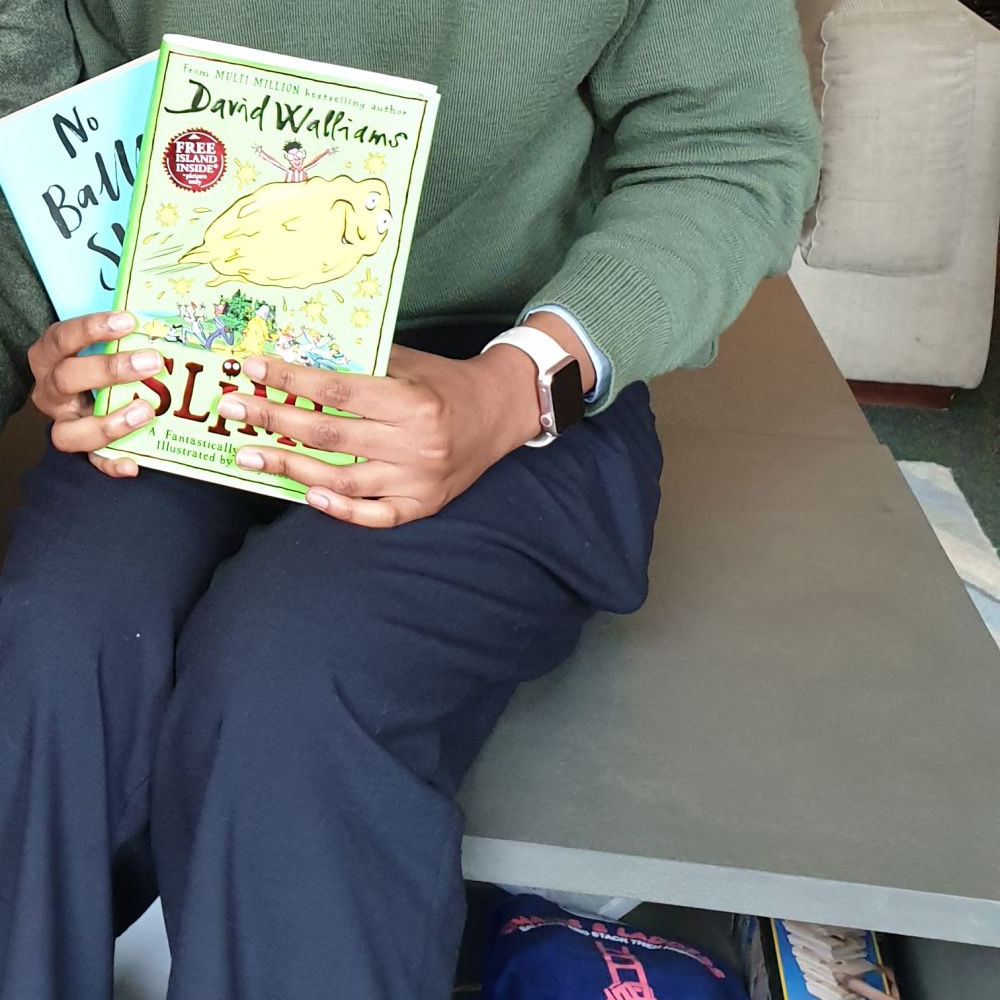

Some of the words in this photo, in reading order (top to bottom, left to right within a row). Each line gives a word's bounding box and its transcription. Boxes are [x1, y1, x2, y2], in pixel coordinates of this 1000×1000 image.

[253, 76, 301, 96] MILLION
[304, 88, 366, 111] bestselling
[370, 101, 407, 116] author
[164, 78, 271, 132] David
[275, 100, 408, 148] Walliams
[52, 106, 99, 159] No
[175, 141, 216, 154] FREE
[175, 153, 218, 164] ISLAND
[148, 426, 156, 437] A
[165, 429, 237, 455] Fantastically
[156, 440, 216, 464] Illustrated
[219, 455, 233, 468] by
